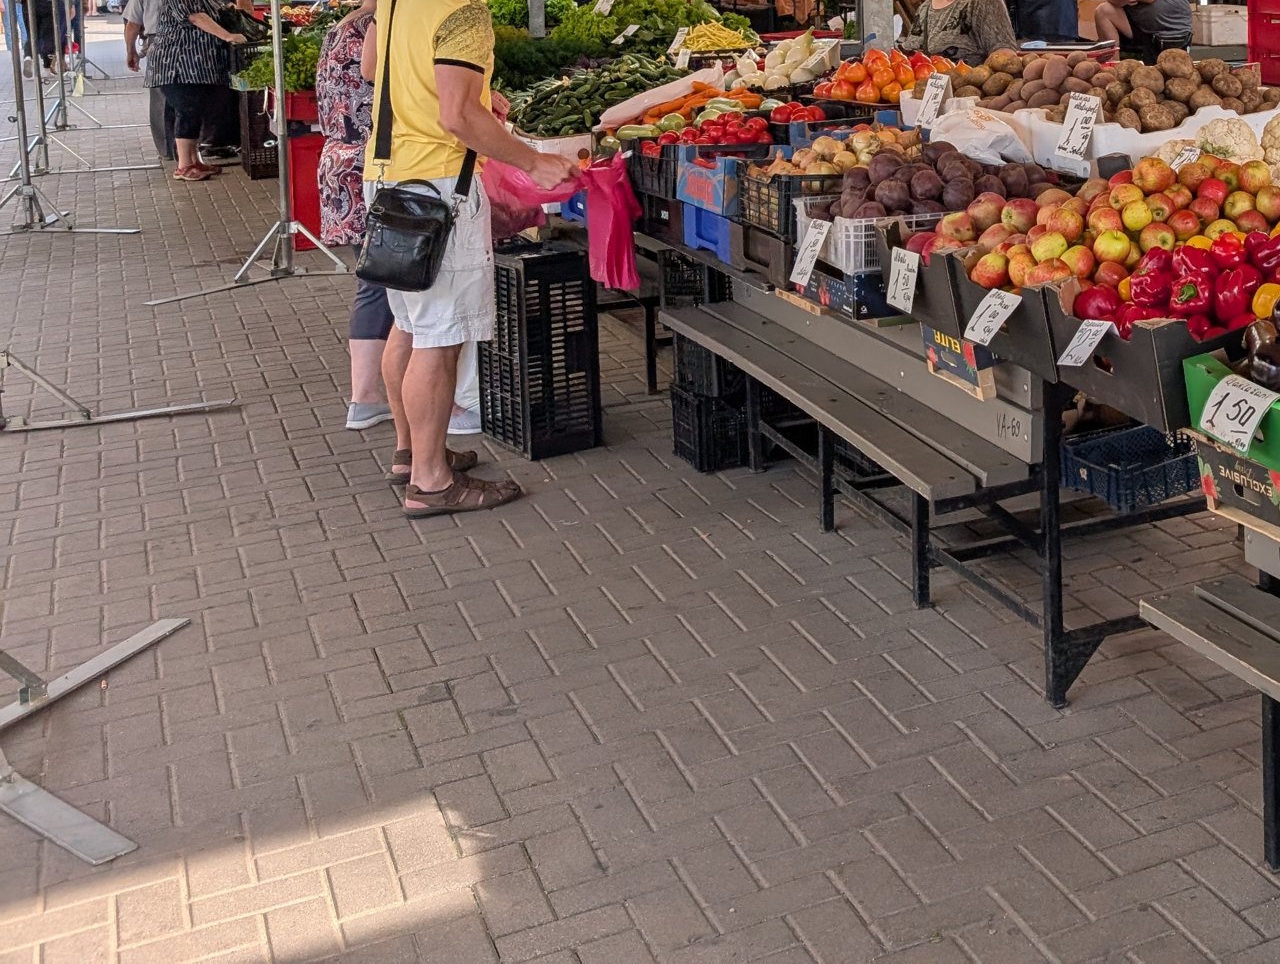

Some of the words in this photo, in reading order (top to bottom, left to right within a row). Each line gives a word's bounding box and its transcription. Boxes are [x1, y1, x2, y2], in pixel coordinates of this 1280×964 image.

[891, 269, 901, 301] 1
[902, 273, 910, 287] 50
[969, 304, 991, 332] 1
[932, 328, 961, 354] ELITA
[1205, 392, 1231, 428] 1
[1226, 398, 1256, 427] 50
[1218, 464, 1273, 497] EXCLUSIVE
